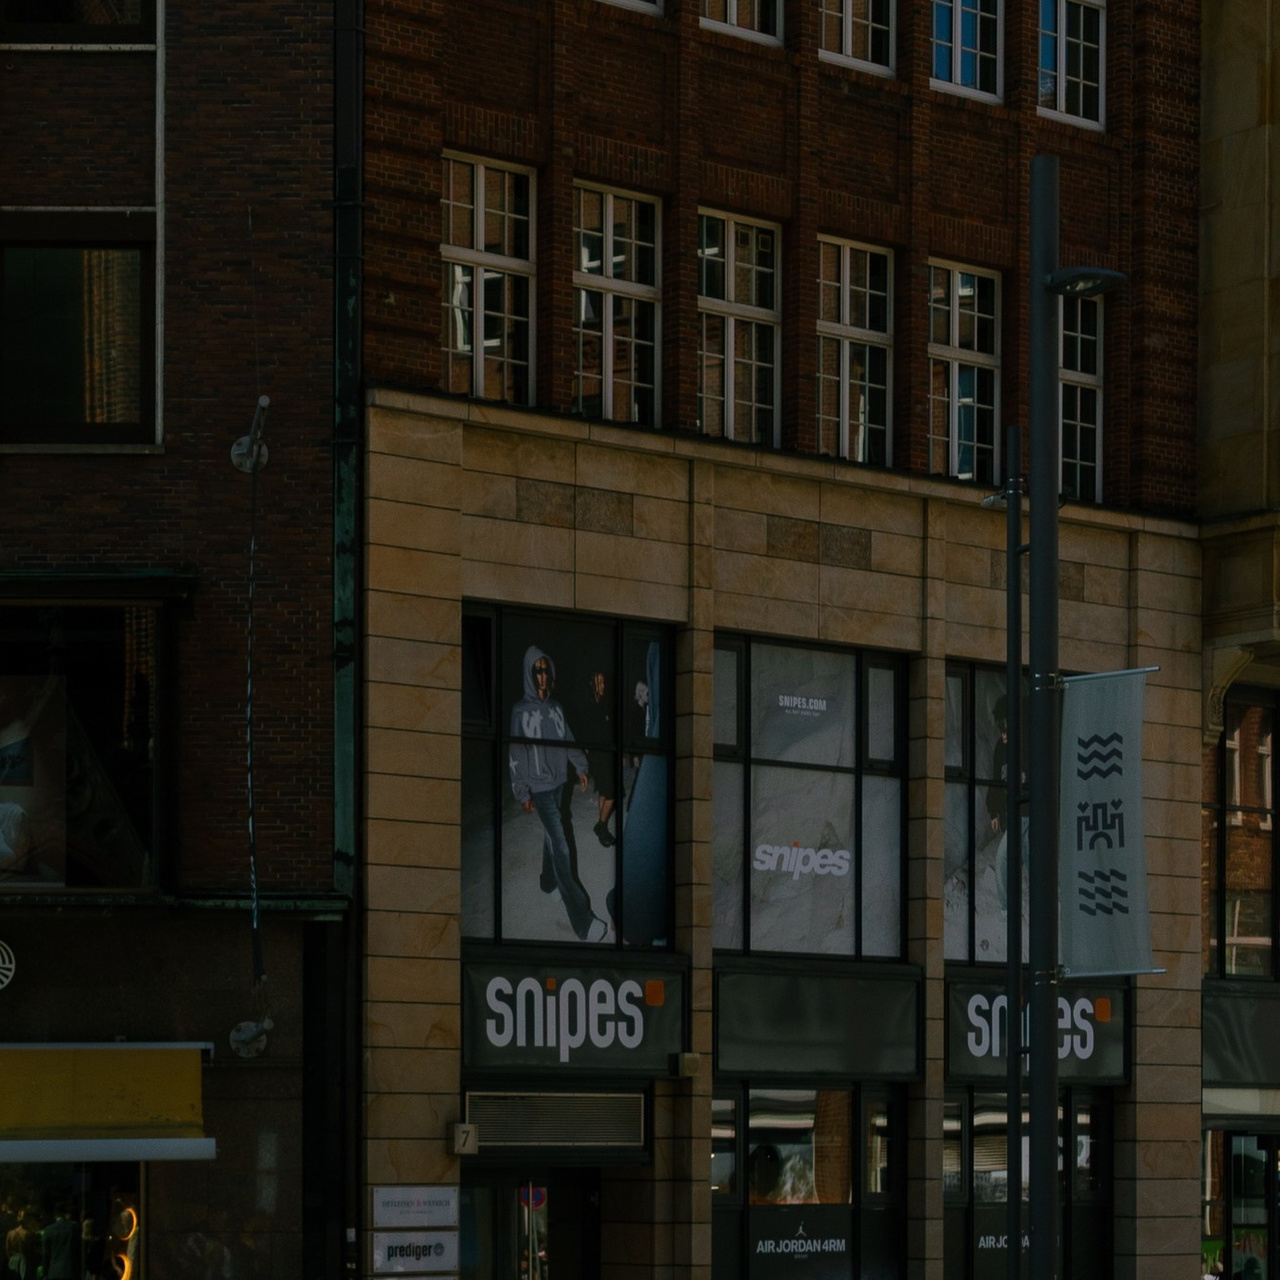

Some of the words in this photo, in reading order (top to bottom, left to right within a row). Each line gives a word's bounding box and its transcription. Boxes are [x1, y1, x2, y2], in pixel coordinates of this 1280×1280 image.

[778, 695, 827, 712] SNIPES.COM
[753, 841, 851, 881] snipes
[486, 976, 644, 1063] snipes
[967, 993, 1095, 1072] snes
[461, 1130, 470, 1148] 7
[756, 1239, 776, 1253] AIR
[776, 1239, 821, 1253] JORDAN
[822, 1238, 846, 1252] 4RM
[978, 1234, 996, 1249] AIR
[387, 1242, 433, 1261] prediger
